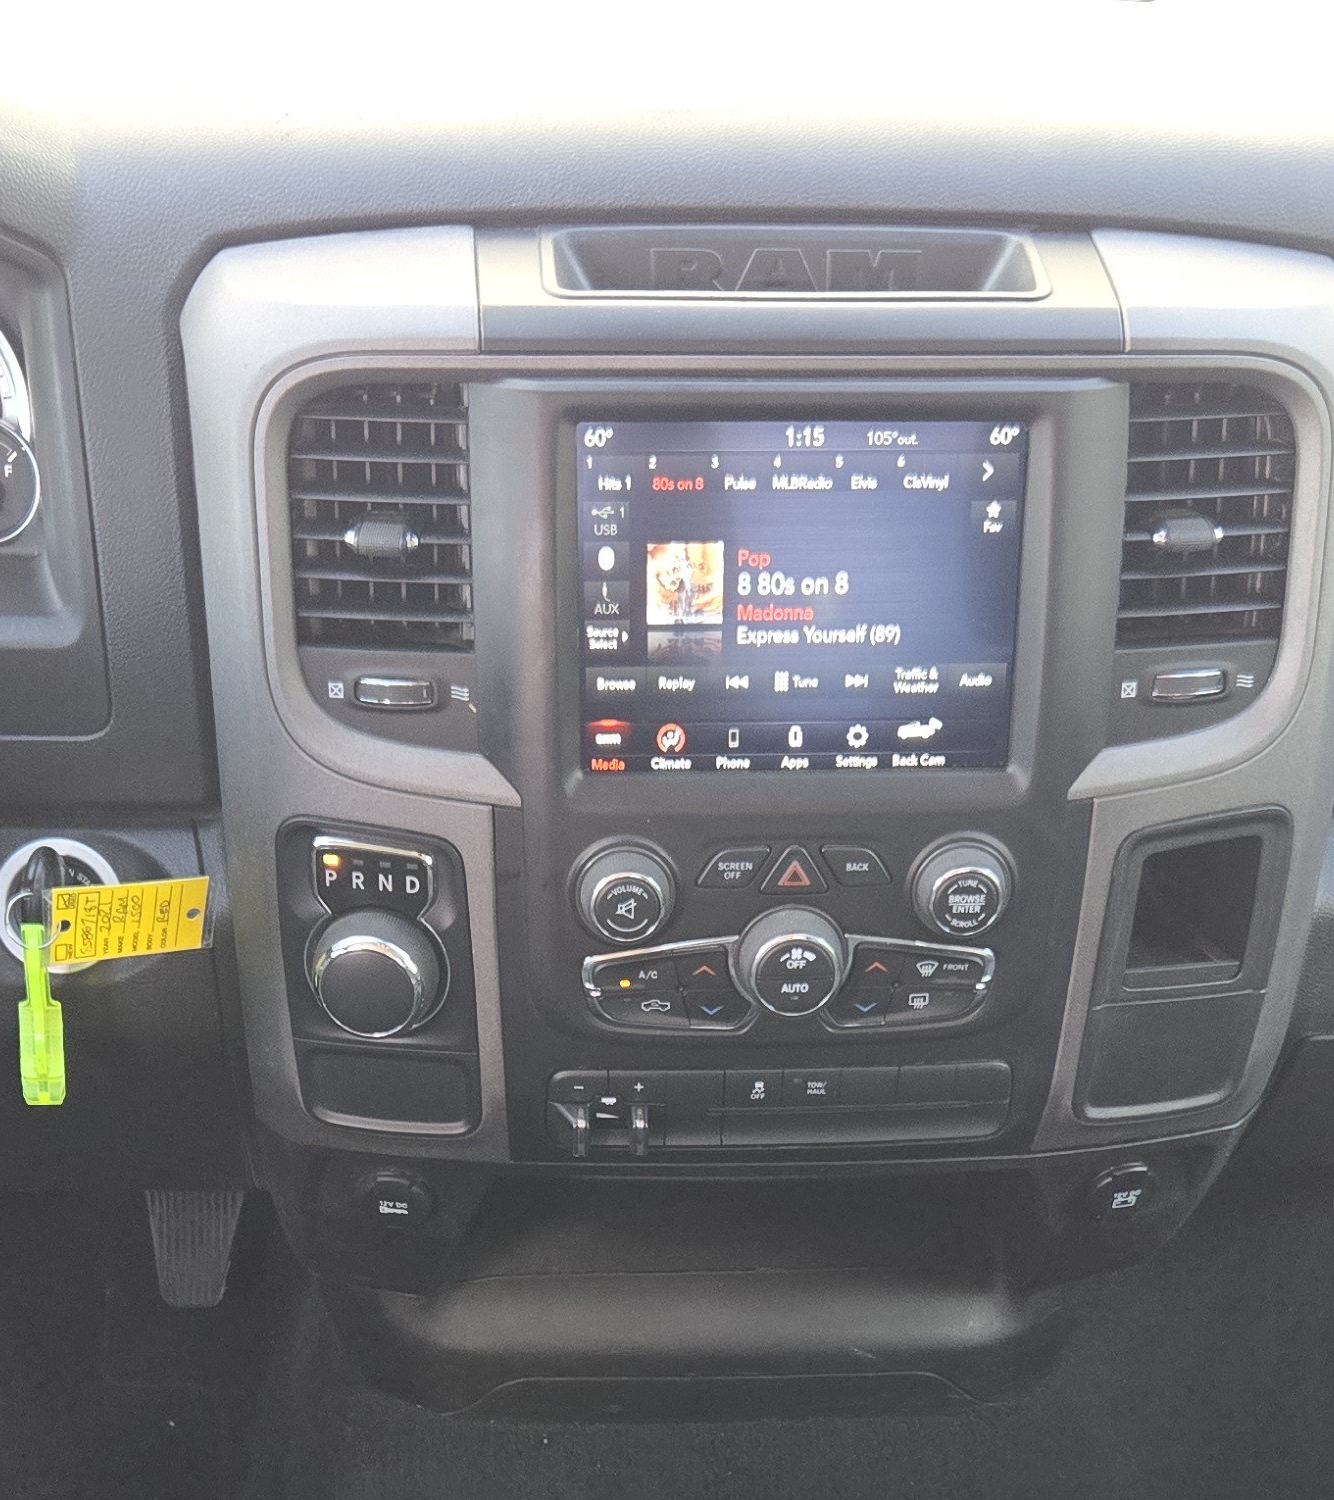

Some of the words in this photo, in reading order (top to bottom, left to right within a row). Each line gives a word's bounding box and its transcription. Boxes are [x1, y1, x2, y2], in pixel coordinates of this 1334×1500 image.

[650, 248, 922, 291] RAM
[584, 426, 614, 448] 60°
[785, 425, 826, 448] 1:15
[990, 424, 1021, 446] 60°
[586, 454, 593, 470] 1
[648, 453, 657, 470] 2
[710, 453, 719, 469] 3
[773, 452, 782, 469] 4
[835, 453, 844, 469] 5
[896, 452, 906, 468] 6
[4, 465, 13, 478] F
[598, 474, 623, 491] Hits
[625, 474, 632, 491] 1
[651, 475, 674, 491] 80s
[677, 478, 693, 491] on
[695, 475, 705, 491] 8
[724, 473, 757, 491] Pulse
[772, 473, 834, 491] MLBRadio
[850, 472, 879, 490] Elvis
[594, 524, 618, 536] USB
[983, 521, 1004, 533] Fav
[737, 549, 771, 570] Pop
[737, 571, 751, 596] 8
[757, 571, 795, 596] 80s
[800, 576, 829, 596] on
[835, 570, 849, 596] 8
[594, 603, 620, 615] AUX
[736, 603, 814, 622] Madonna
[587, 625, 619, 638] Source
[736, 624, 800, 648] Express
[803, 623, 868, 645] Yourself
[869, 623, 901, 646] (89)
[894, 666, 928, 681] Traffic
[928, 666, 939, 681] &
[959, 673, 993, 688] Audio
[597, 676, 637, 691] Browse
[658, 675, 696, 692] Replay
[792, 674, 819, 689] Tune
[893, 681, 940, 695] Weather
[591, 758, 626, 771] Media
[650, 756, 692, 771] Climate
[715, 756, 751, 771] Phone
[780, 755, 809, 770] Apps
[835, 755, 878, 770] Settings
[892, 753, 918, 768] Back
[919, 752, 946, 768] Cam
[718, 862, 754, 871] SCREEN
[845, 863, 869, 872] BACK
[325, 869, 338, 887] P
[352, 872, 365, 890] R
[378, 873, 393, 892] N
[405, 875, 420, 894] D
[724, 872, 741, 880] OFF
[958, 879, 979, 888] TUNE
[611, 885, 644, 896] VOLUME
[948, 894, 987, 904] BROWSE
[129, 895, 142, 923] 1500
[952, 905, 982, 914] ENTER
[99, 901, 112, 933] 2021
[145, 933, 153, 950] BODY
[160, 927, 168, 948] COLOR
[786, 960, 807, 970] OFF
[942, 963, 969, 971] FRONT
[638, 970, 658, 980] A/C
[780, 982, 809, 993] AUTO
[807, 1081, 827, 1089] TOW/
[750, 1092, 766, 1100] OFF
